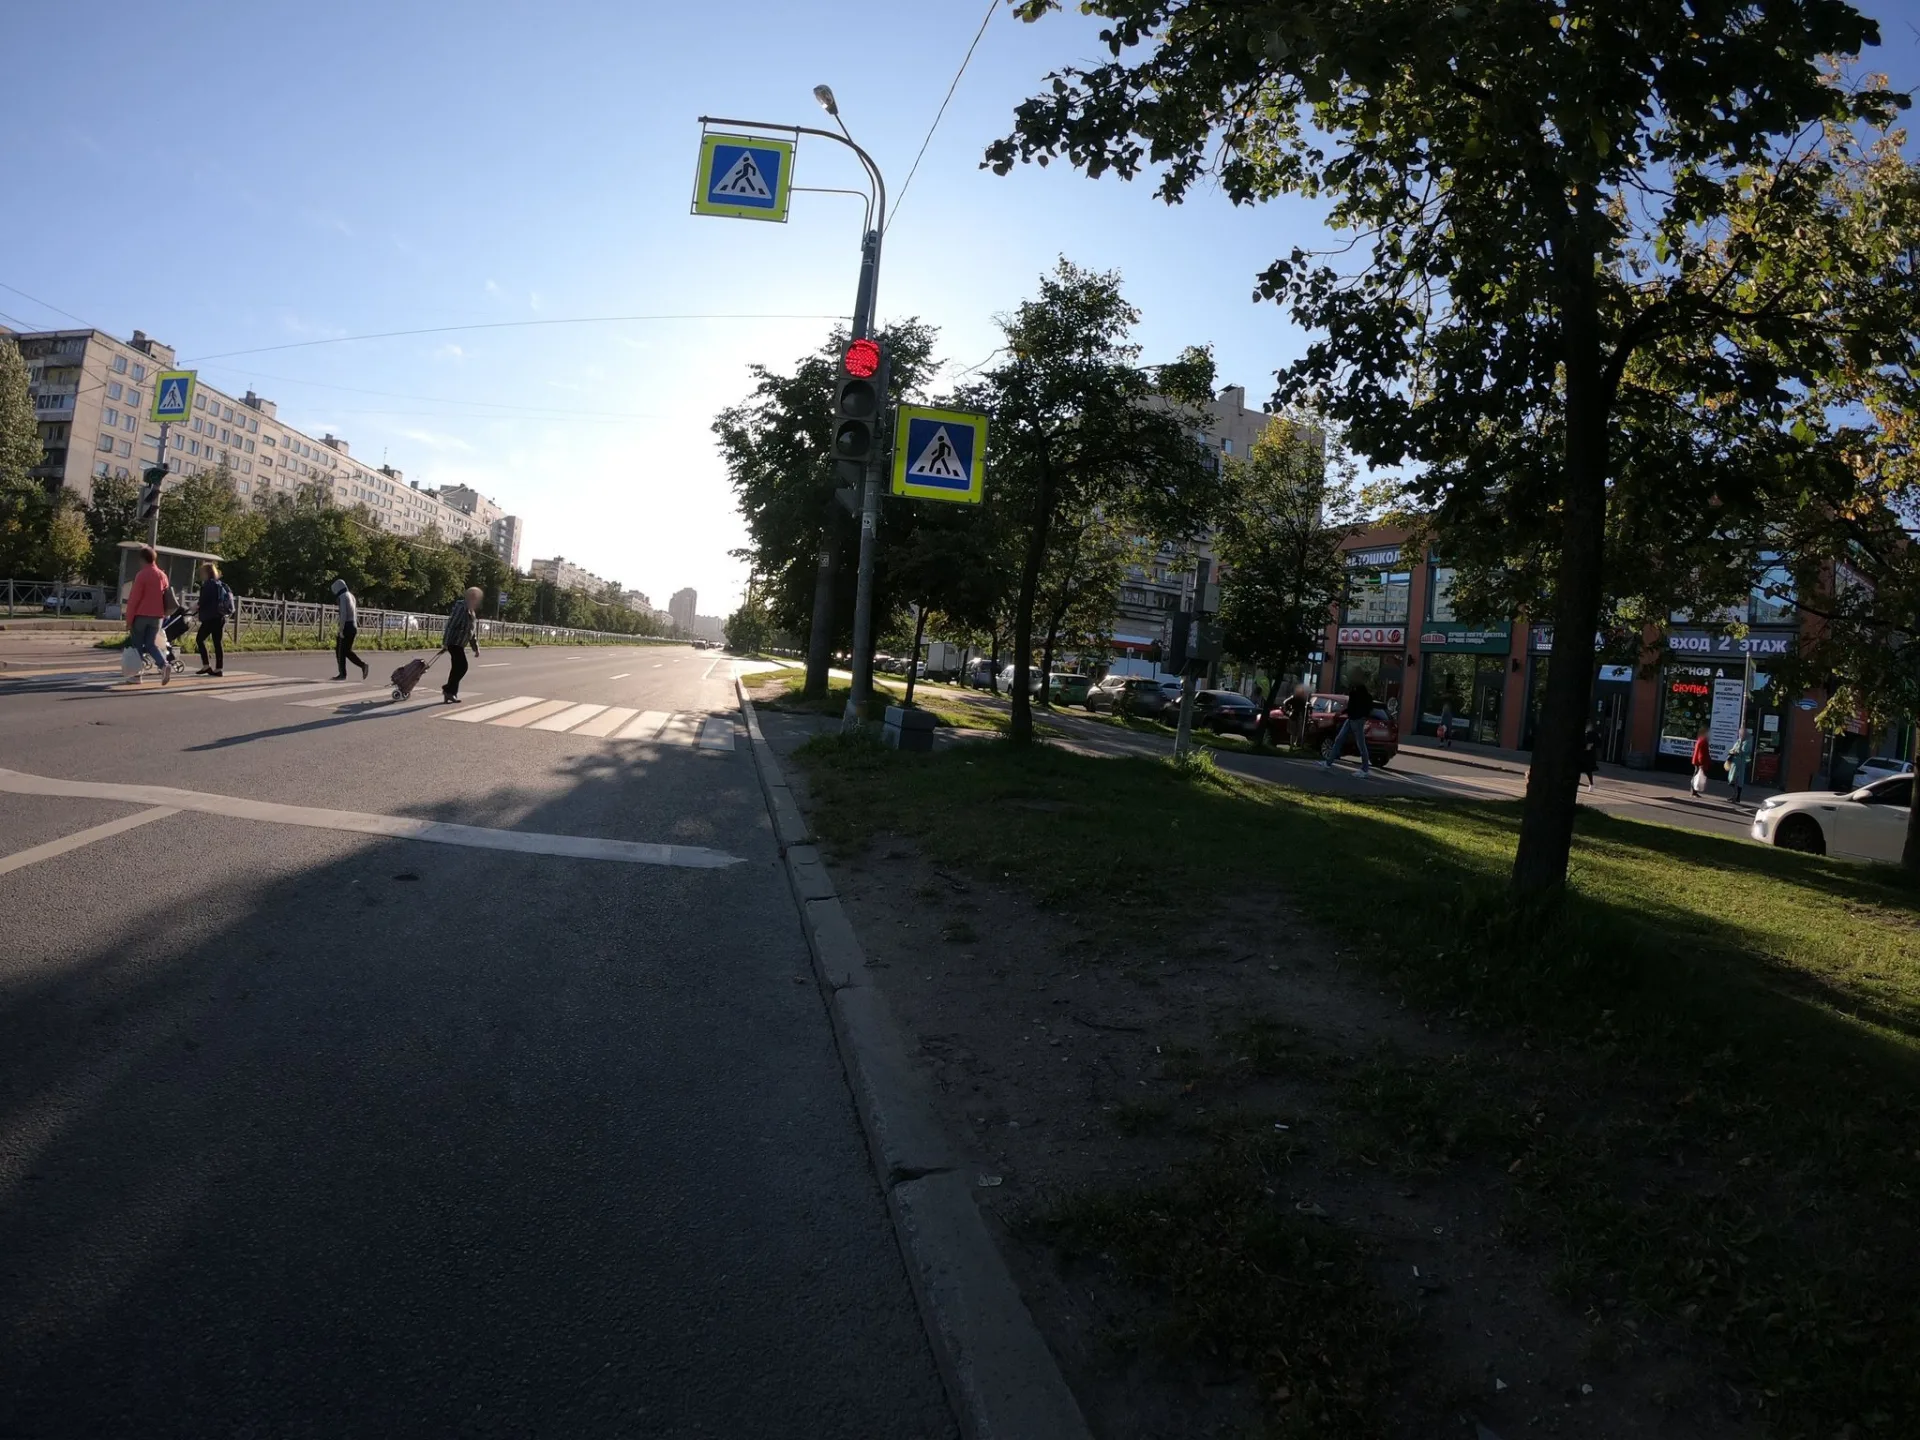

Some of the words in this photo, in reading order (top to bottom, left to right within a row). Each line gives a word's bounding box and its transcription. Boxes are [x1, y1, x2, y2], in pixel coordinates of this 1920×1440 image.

[1669, 637, 1710, 652] ВХОД
[1718, 635, 1730, 651] 2
[1738, 639, 1787, 653] ЭТАЖ
[1672, 683, 1708, 695] СКУПКА
